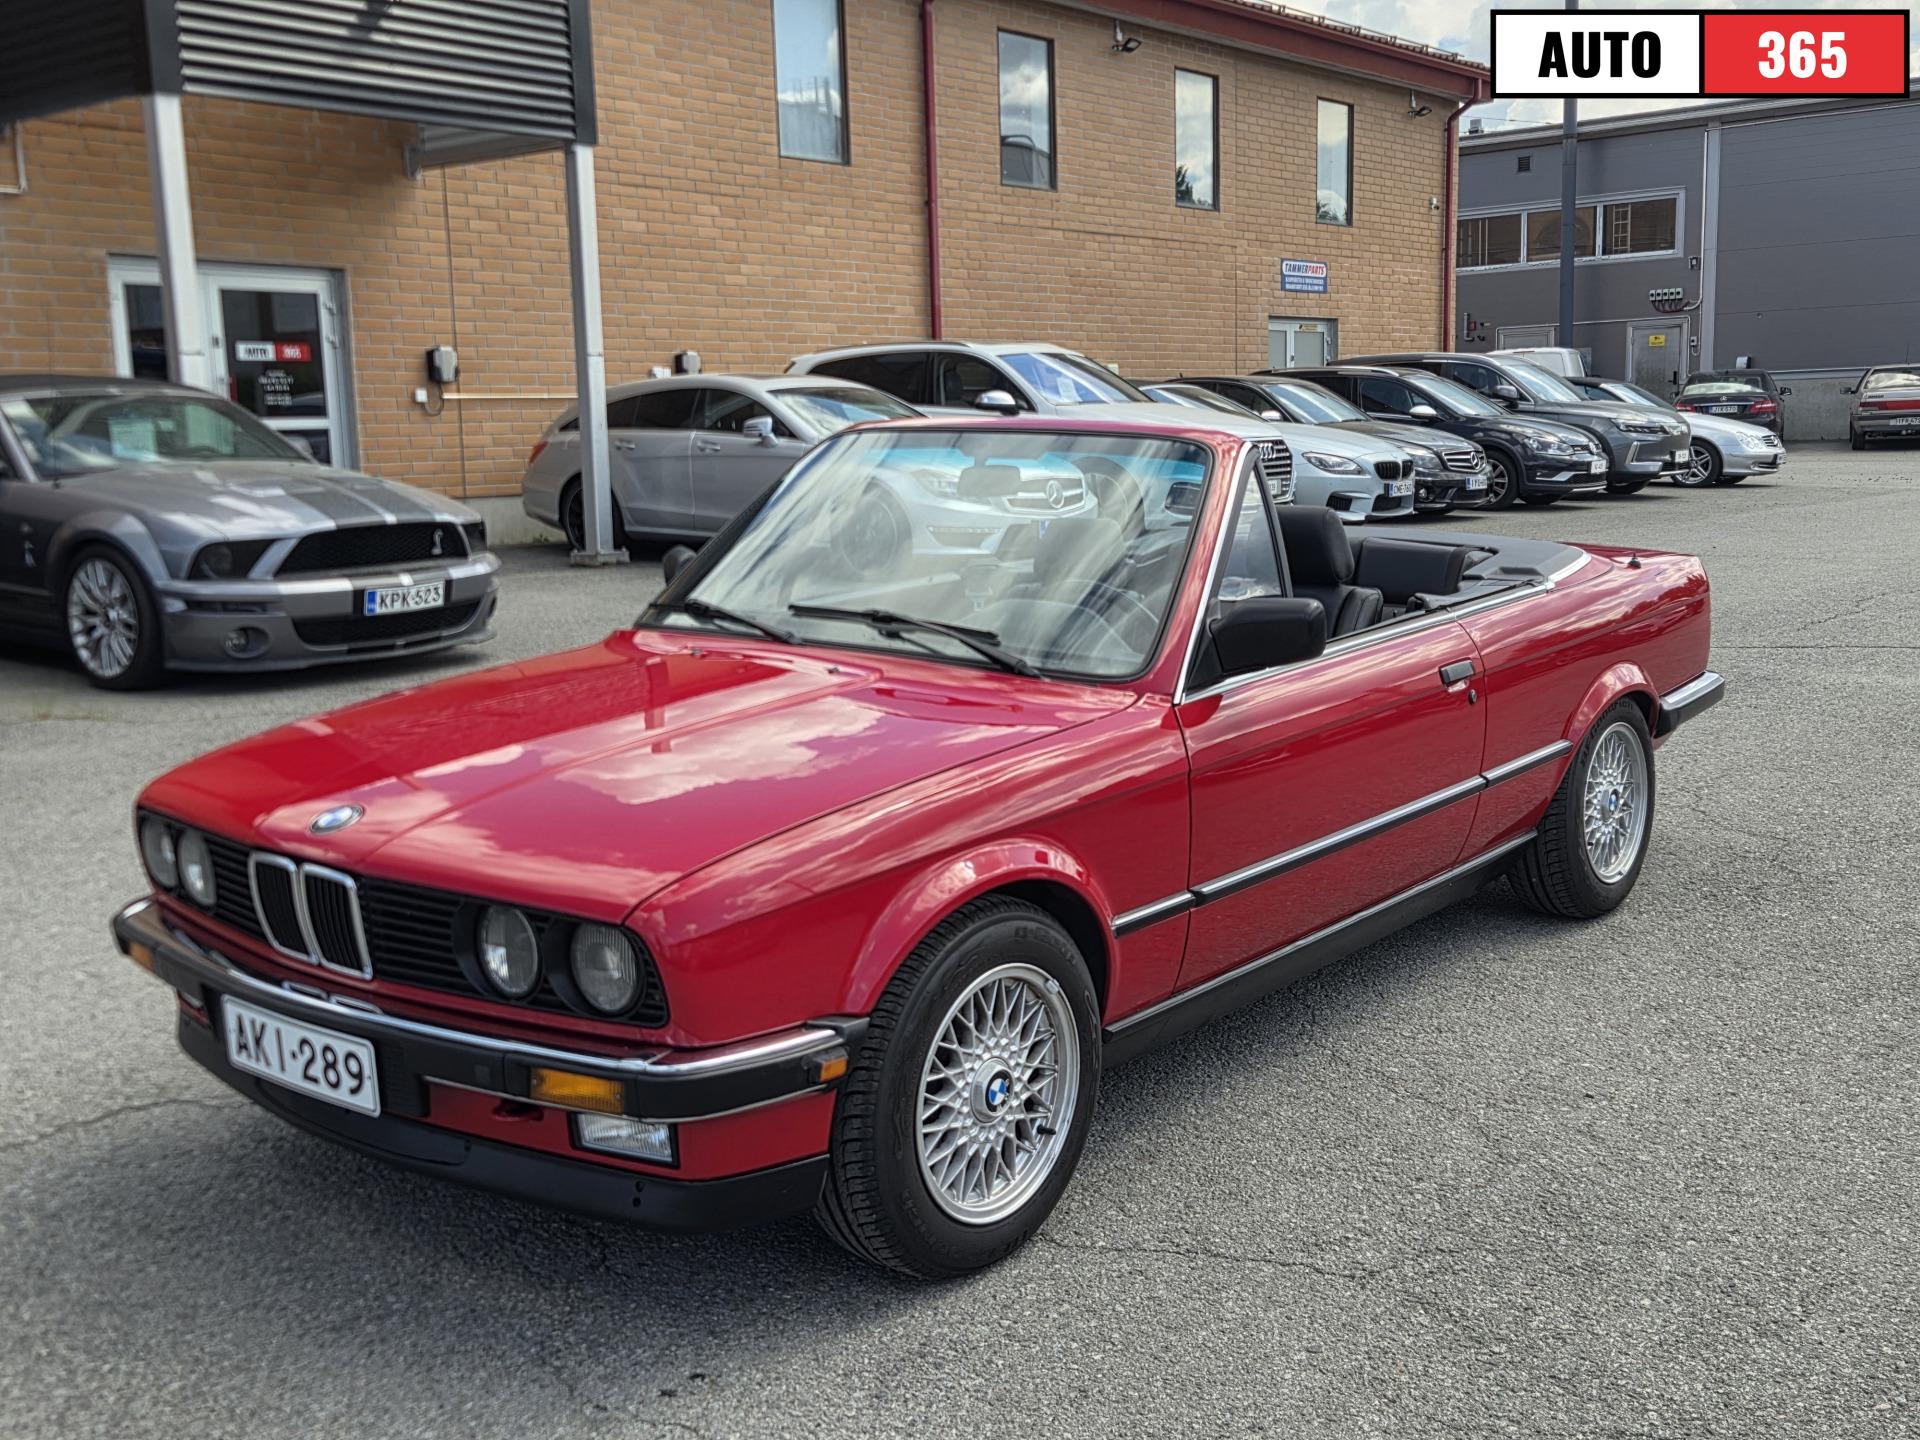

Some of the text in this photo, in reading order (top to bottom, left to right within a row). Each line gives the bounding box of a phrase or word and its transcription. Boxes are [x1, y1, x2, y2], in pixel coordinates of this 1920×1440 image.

[1285, 263, 1325, 276] TAMMERPARTS
[379, 586, 441, 609] KPK-523
[236, 1013, 364, 1095] AKI-289
